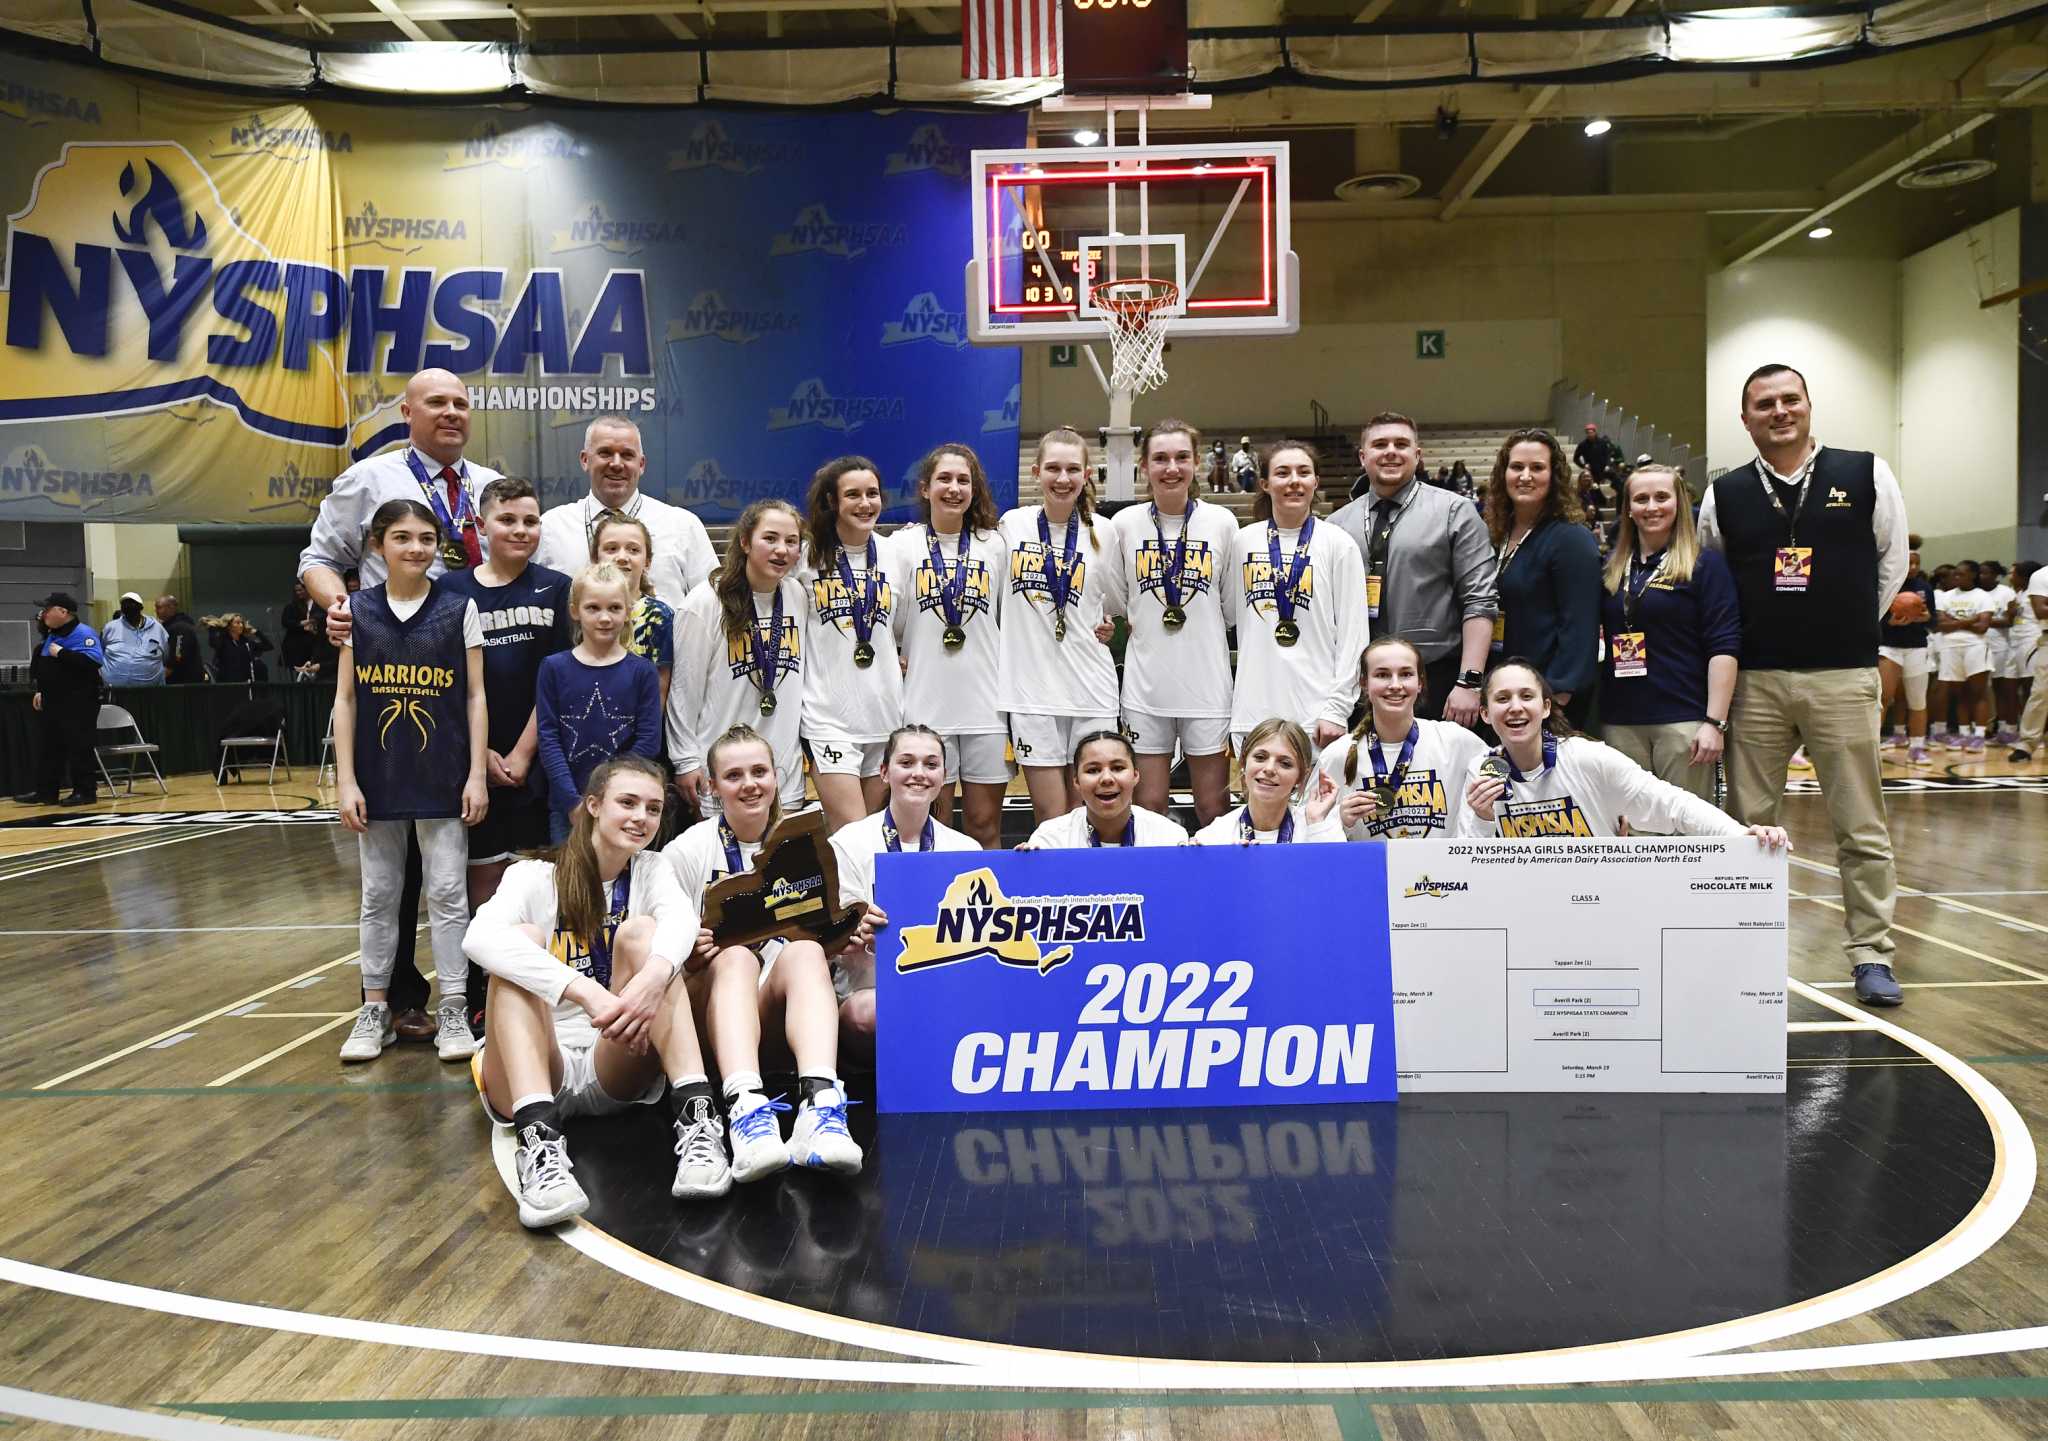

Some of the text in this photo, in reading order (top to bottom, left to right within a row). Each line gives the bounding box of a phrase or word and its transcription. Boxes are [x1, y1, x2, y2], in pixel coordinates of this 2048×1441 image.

[344, 215, 467, 240] NYSPHSAA
[570, 220, 687, 242] NYSPHSAA
[6, 230, 652, 376] NYSPHSAA
[1057, 345, 1070, 361] J
[1422, 335, 1438, 354] K
[466, 386, 656, 411] HAMPIONSHIPS
[787, 398, 905, 421] NYSPHSAA
[2, 467, 153, 496] NYSPHSAA
[480, 606, 555, 632] RRIORS
[482, 632, 535, 647] ASKETBALL
[356, 664, 454, 688] WARRIORS
[372, 687, 441, 697] BASKETBALL
[823, 744, 843, 764] AP
[1016, 737, 1033, 757] AP
[1370, 816, 1446, 834] STATE CHAMPION
[1448, 844, 1726, 855] 2022 NYSPHSAA GIRLS BASKETBALL CHAMPIONSHIPS
[1471, 855, 1702, 866] Presented by American Dairy Association North East
[773, 876, 822, 898] NYSPHSAA
[1413, 882, 1469, 891] NYSPHSAA
[1750, 882, 1773, 890] MILK
[1012, 895, 1142, 906] Education Through Interscholastic Athletics
[935, 903, 1144, 943] NYSPHSAA
[1077, 961, 1254, 1025] 2022
[951, 1023, 1375, 1095] CHAMPION
